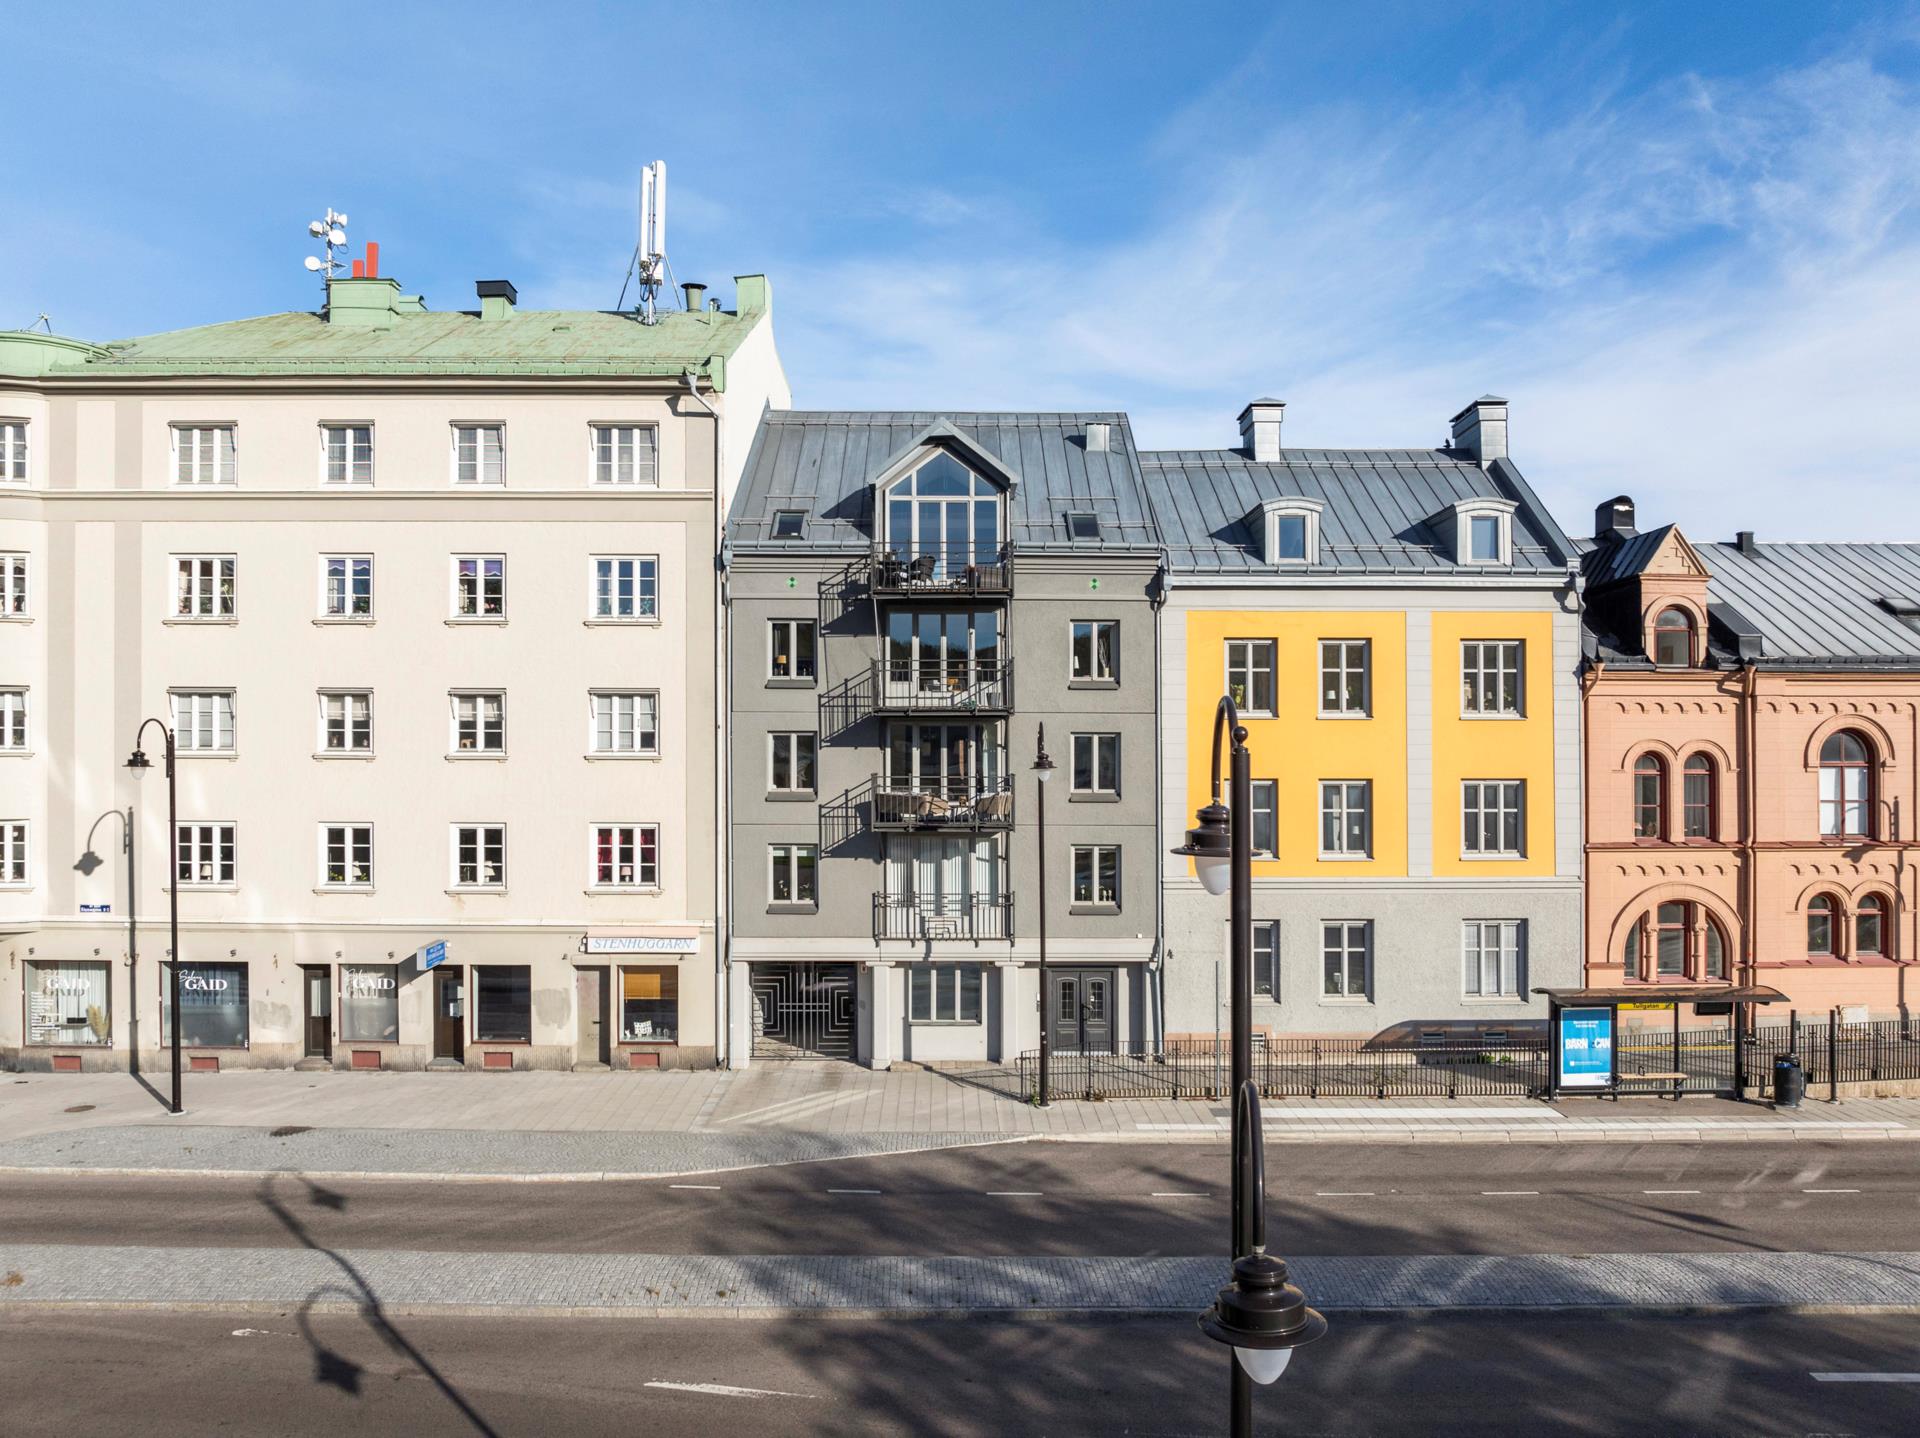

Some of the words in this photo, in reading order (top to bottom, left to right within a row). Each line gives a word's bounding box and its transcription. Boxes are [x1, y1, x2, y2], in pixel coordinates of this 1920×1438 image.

[593, 938, 693, 949] STENHUGGARN
[47, 978, 90, 990] GAID
[185, 979, 228, 990] GAID
[353, 977, 396, 990] GAID
